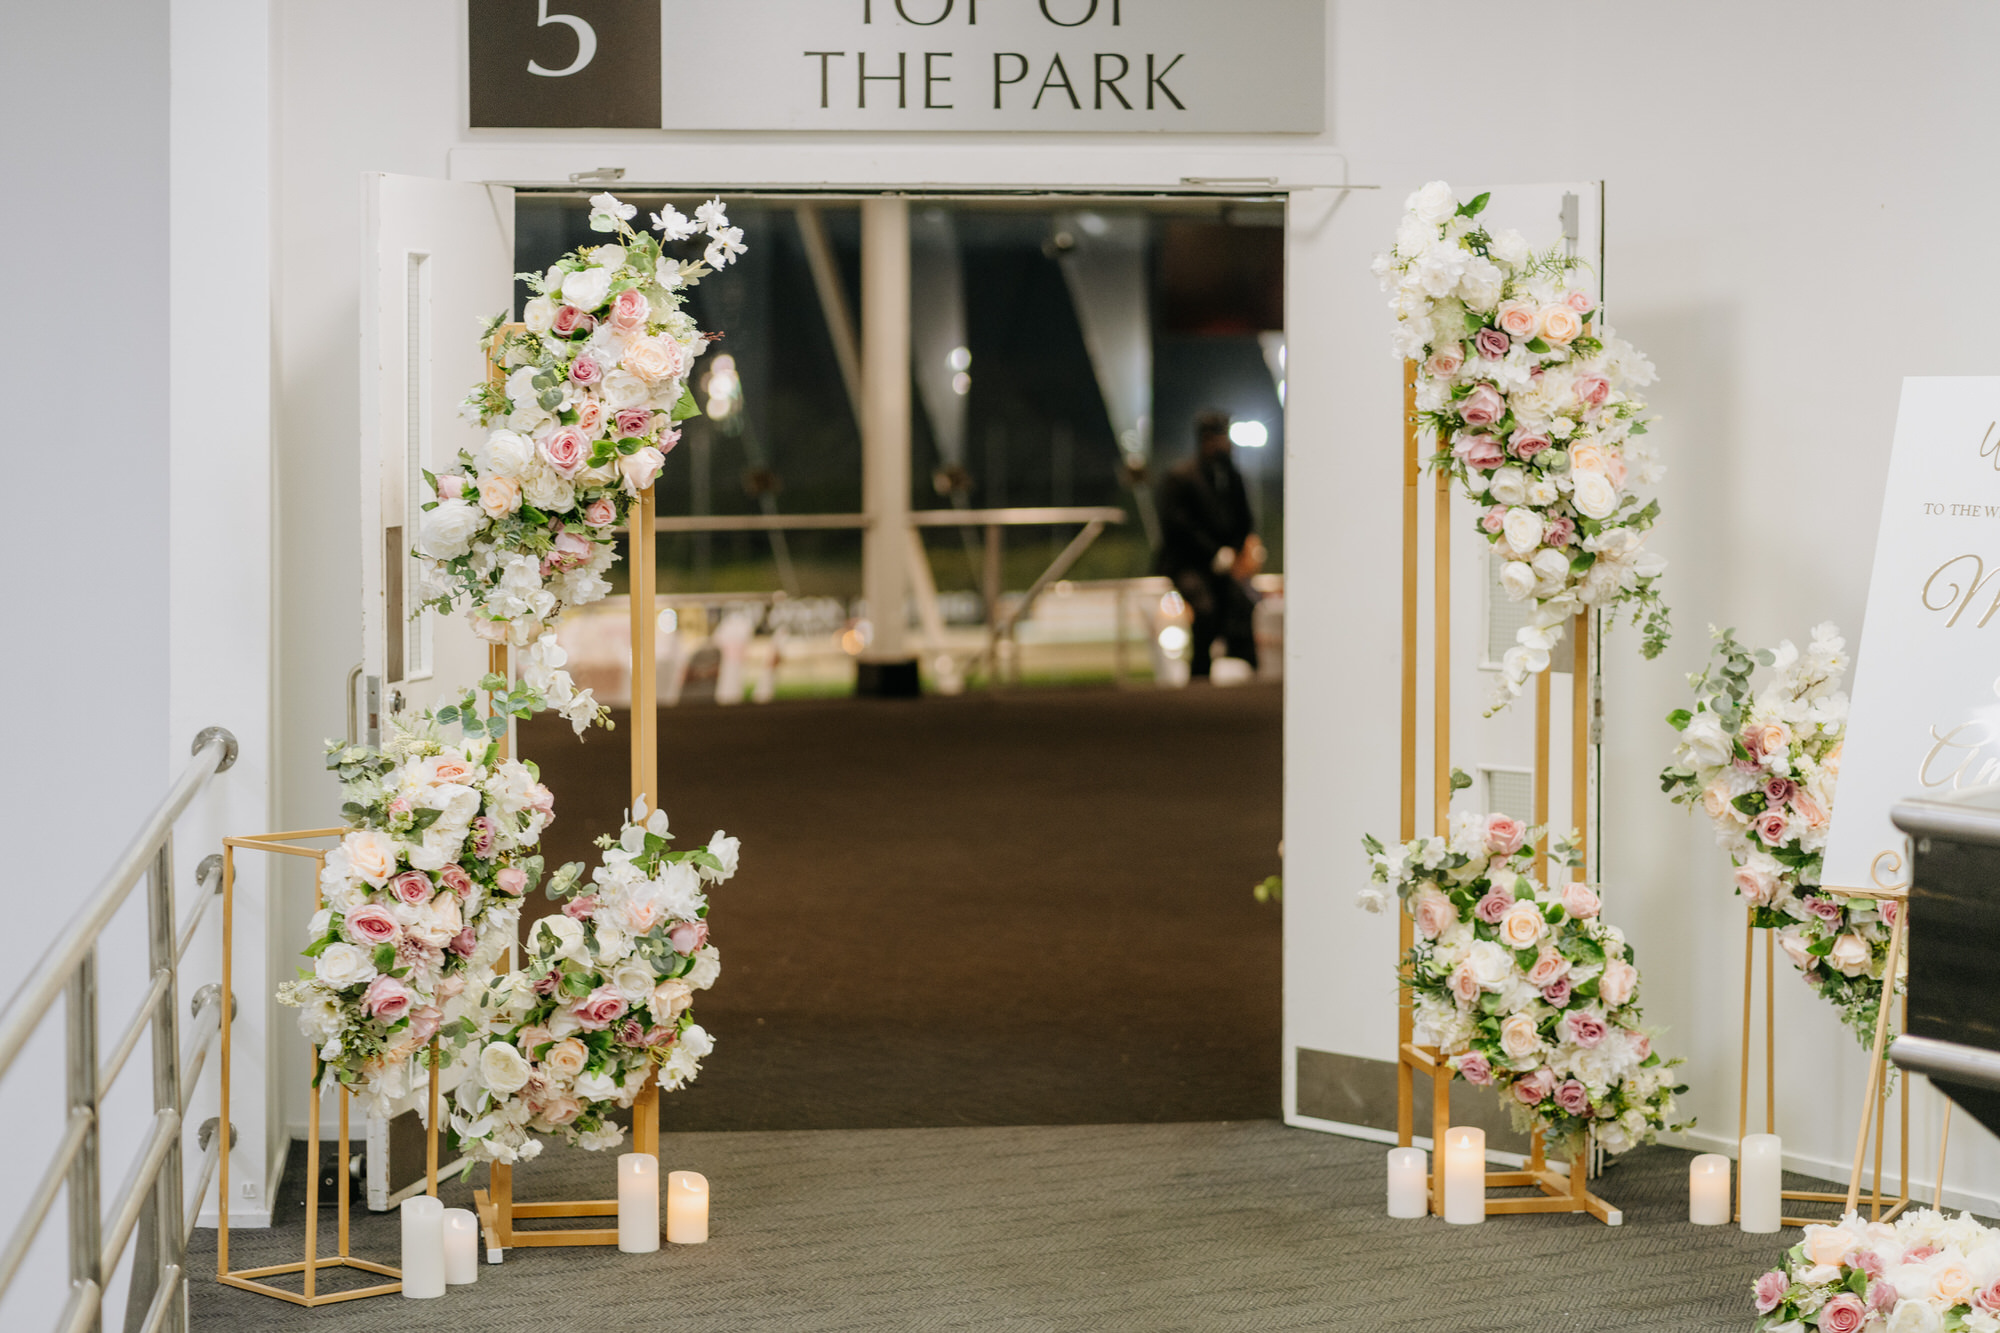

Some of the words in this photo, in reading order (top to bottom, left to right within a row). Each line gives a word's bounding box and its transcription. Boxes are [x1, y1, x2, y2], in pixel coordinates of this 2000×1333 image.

[526, 0, 598, 78] 5
[804, 51, 954, 109] THE
[993, 52, 1187, 110] PARK
[1924, 502, 1945, 516] TO
[1950, 503, 1981, 518] THE
